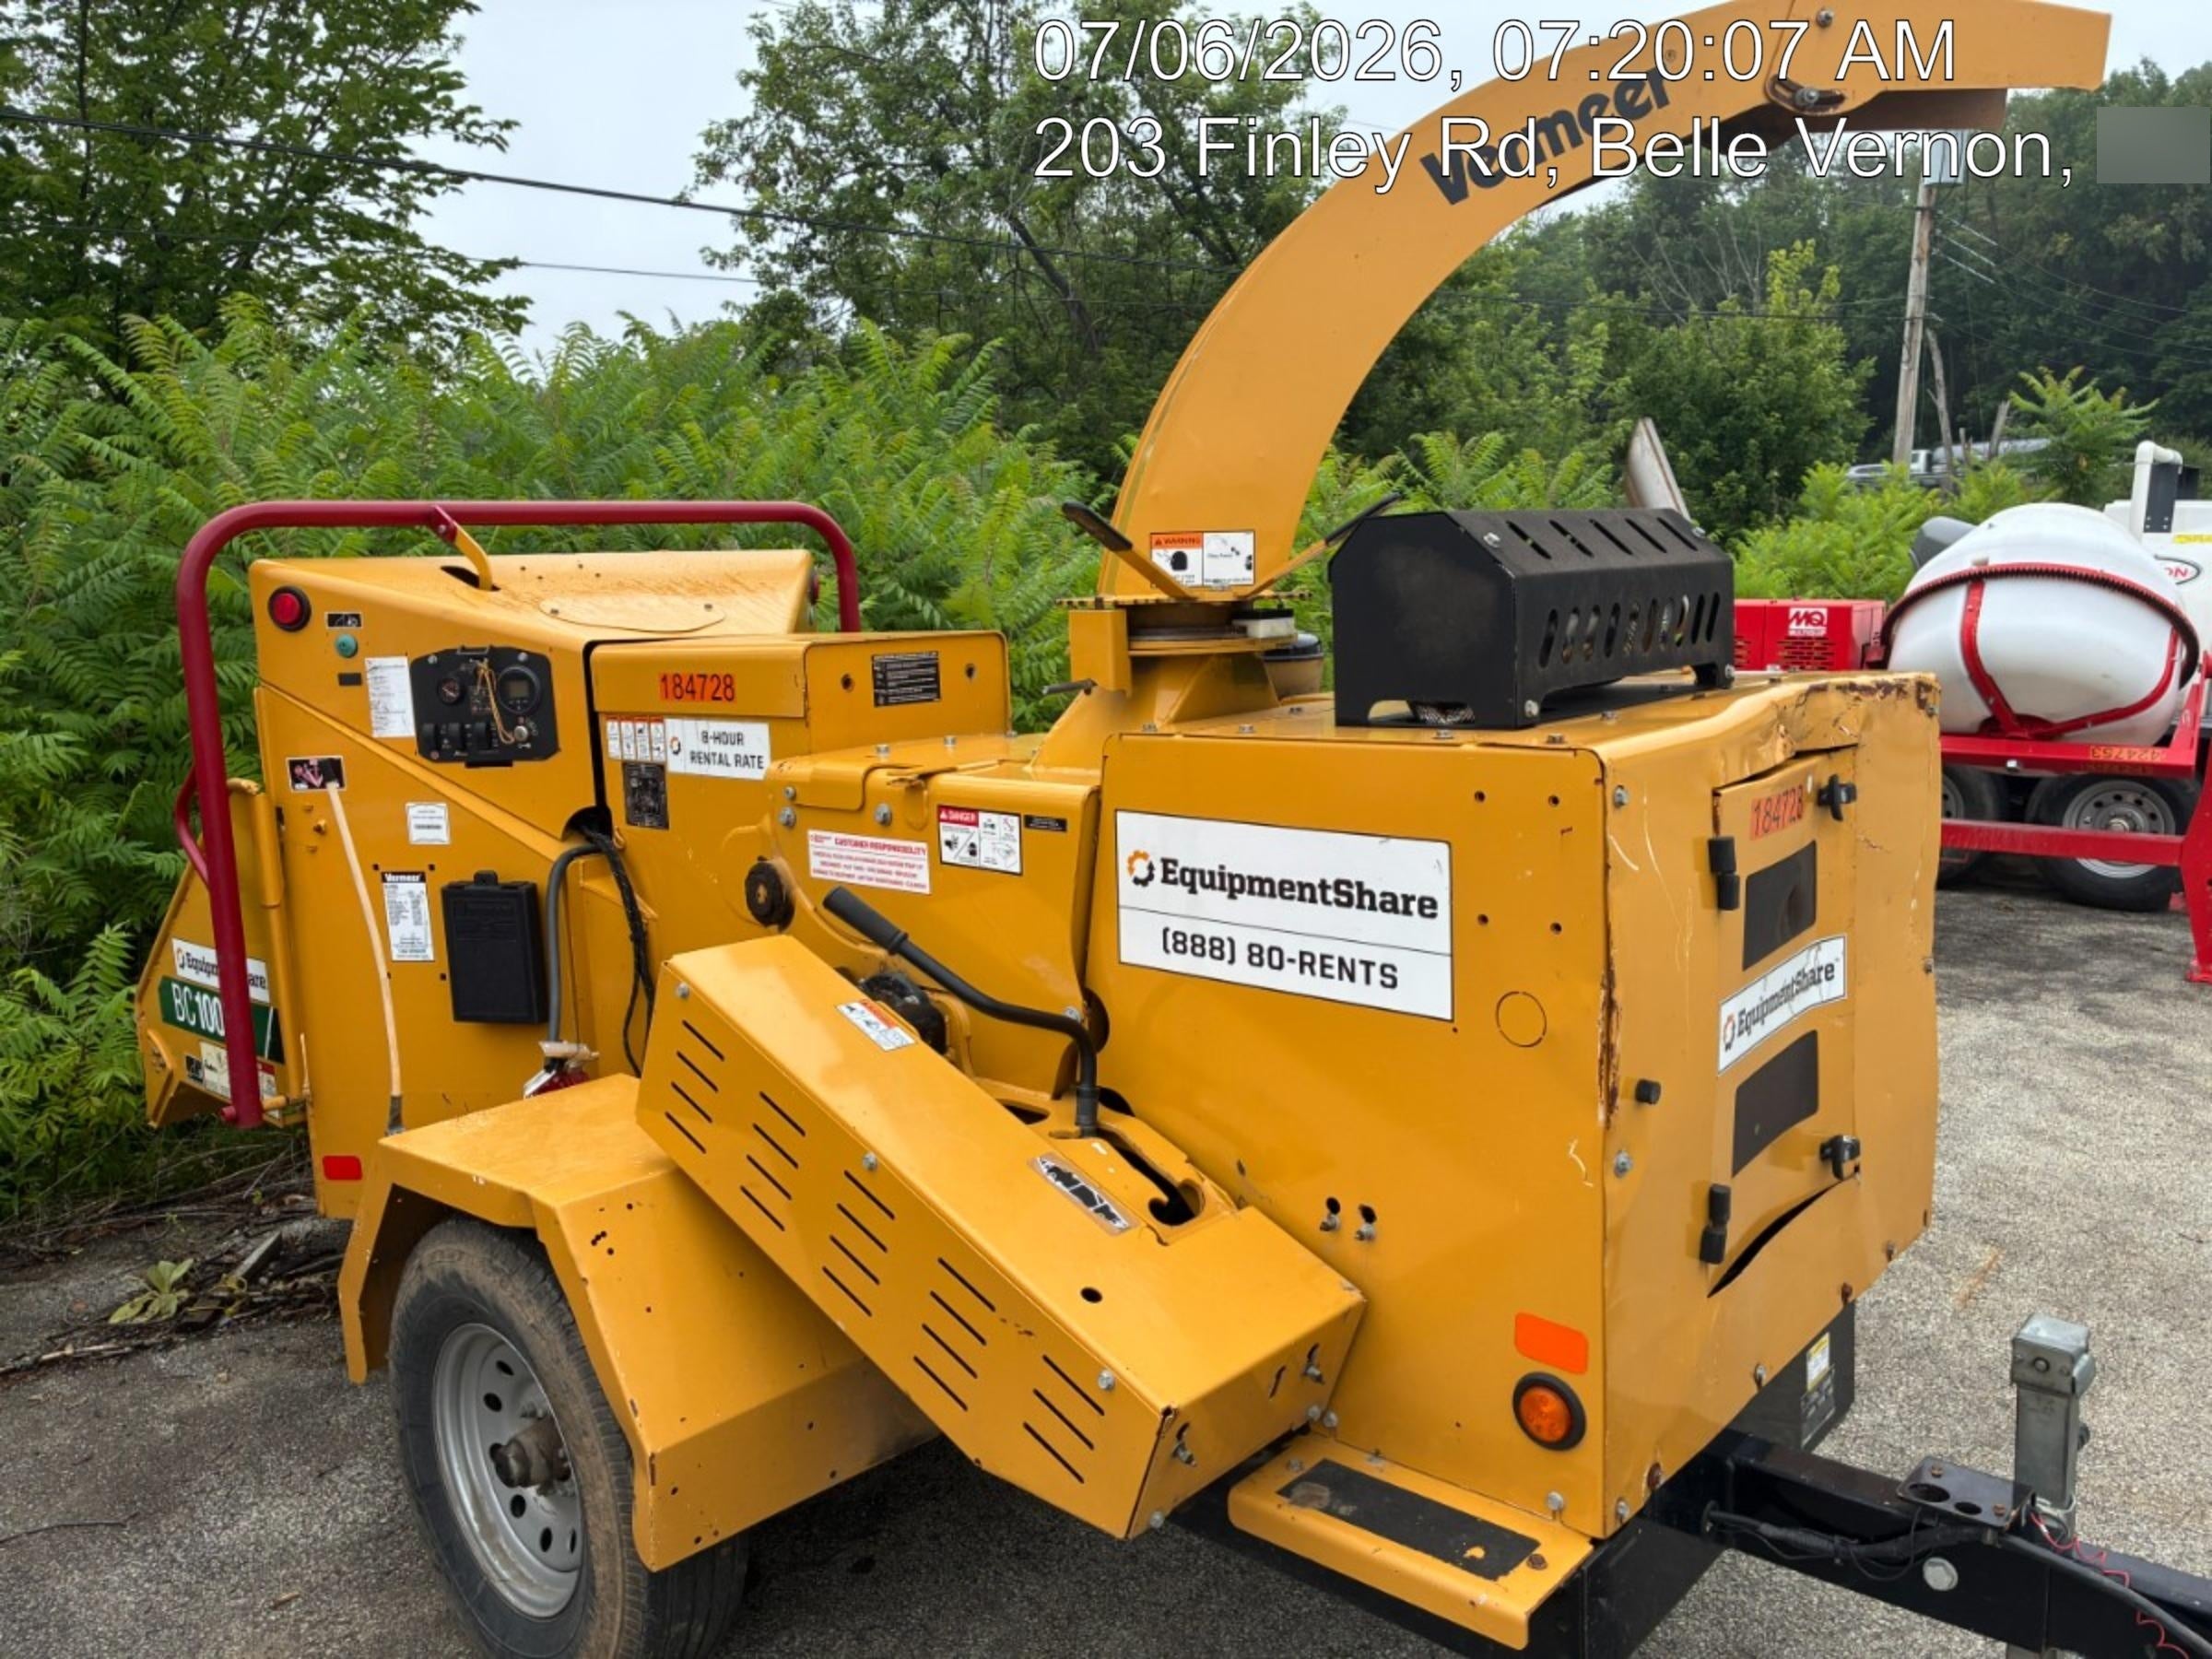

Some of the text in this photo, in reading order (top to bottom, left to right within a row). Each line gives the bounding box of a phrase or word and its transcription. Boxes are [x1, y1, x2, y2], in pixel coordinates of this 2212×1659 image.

[1419, 66, 1672, 205] Vermeer
[1787, 610, 1828, 628] MQ
[660, 673, 735, 702] 184728
[689, 749, 765, 770] RENTAL RATE
[700, 730, 745, 747] 8-HOUR
[1753, 785, 1805, 836] 184728
[1160, 857, 1439, 921] EquipmentShare
[1161, 927, 1399, 990] (888) 80-RENTS
[1736, 959, 1835, 1037] EquipmentShare
